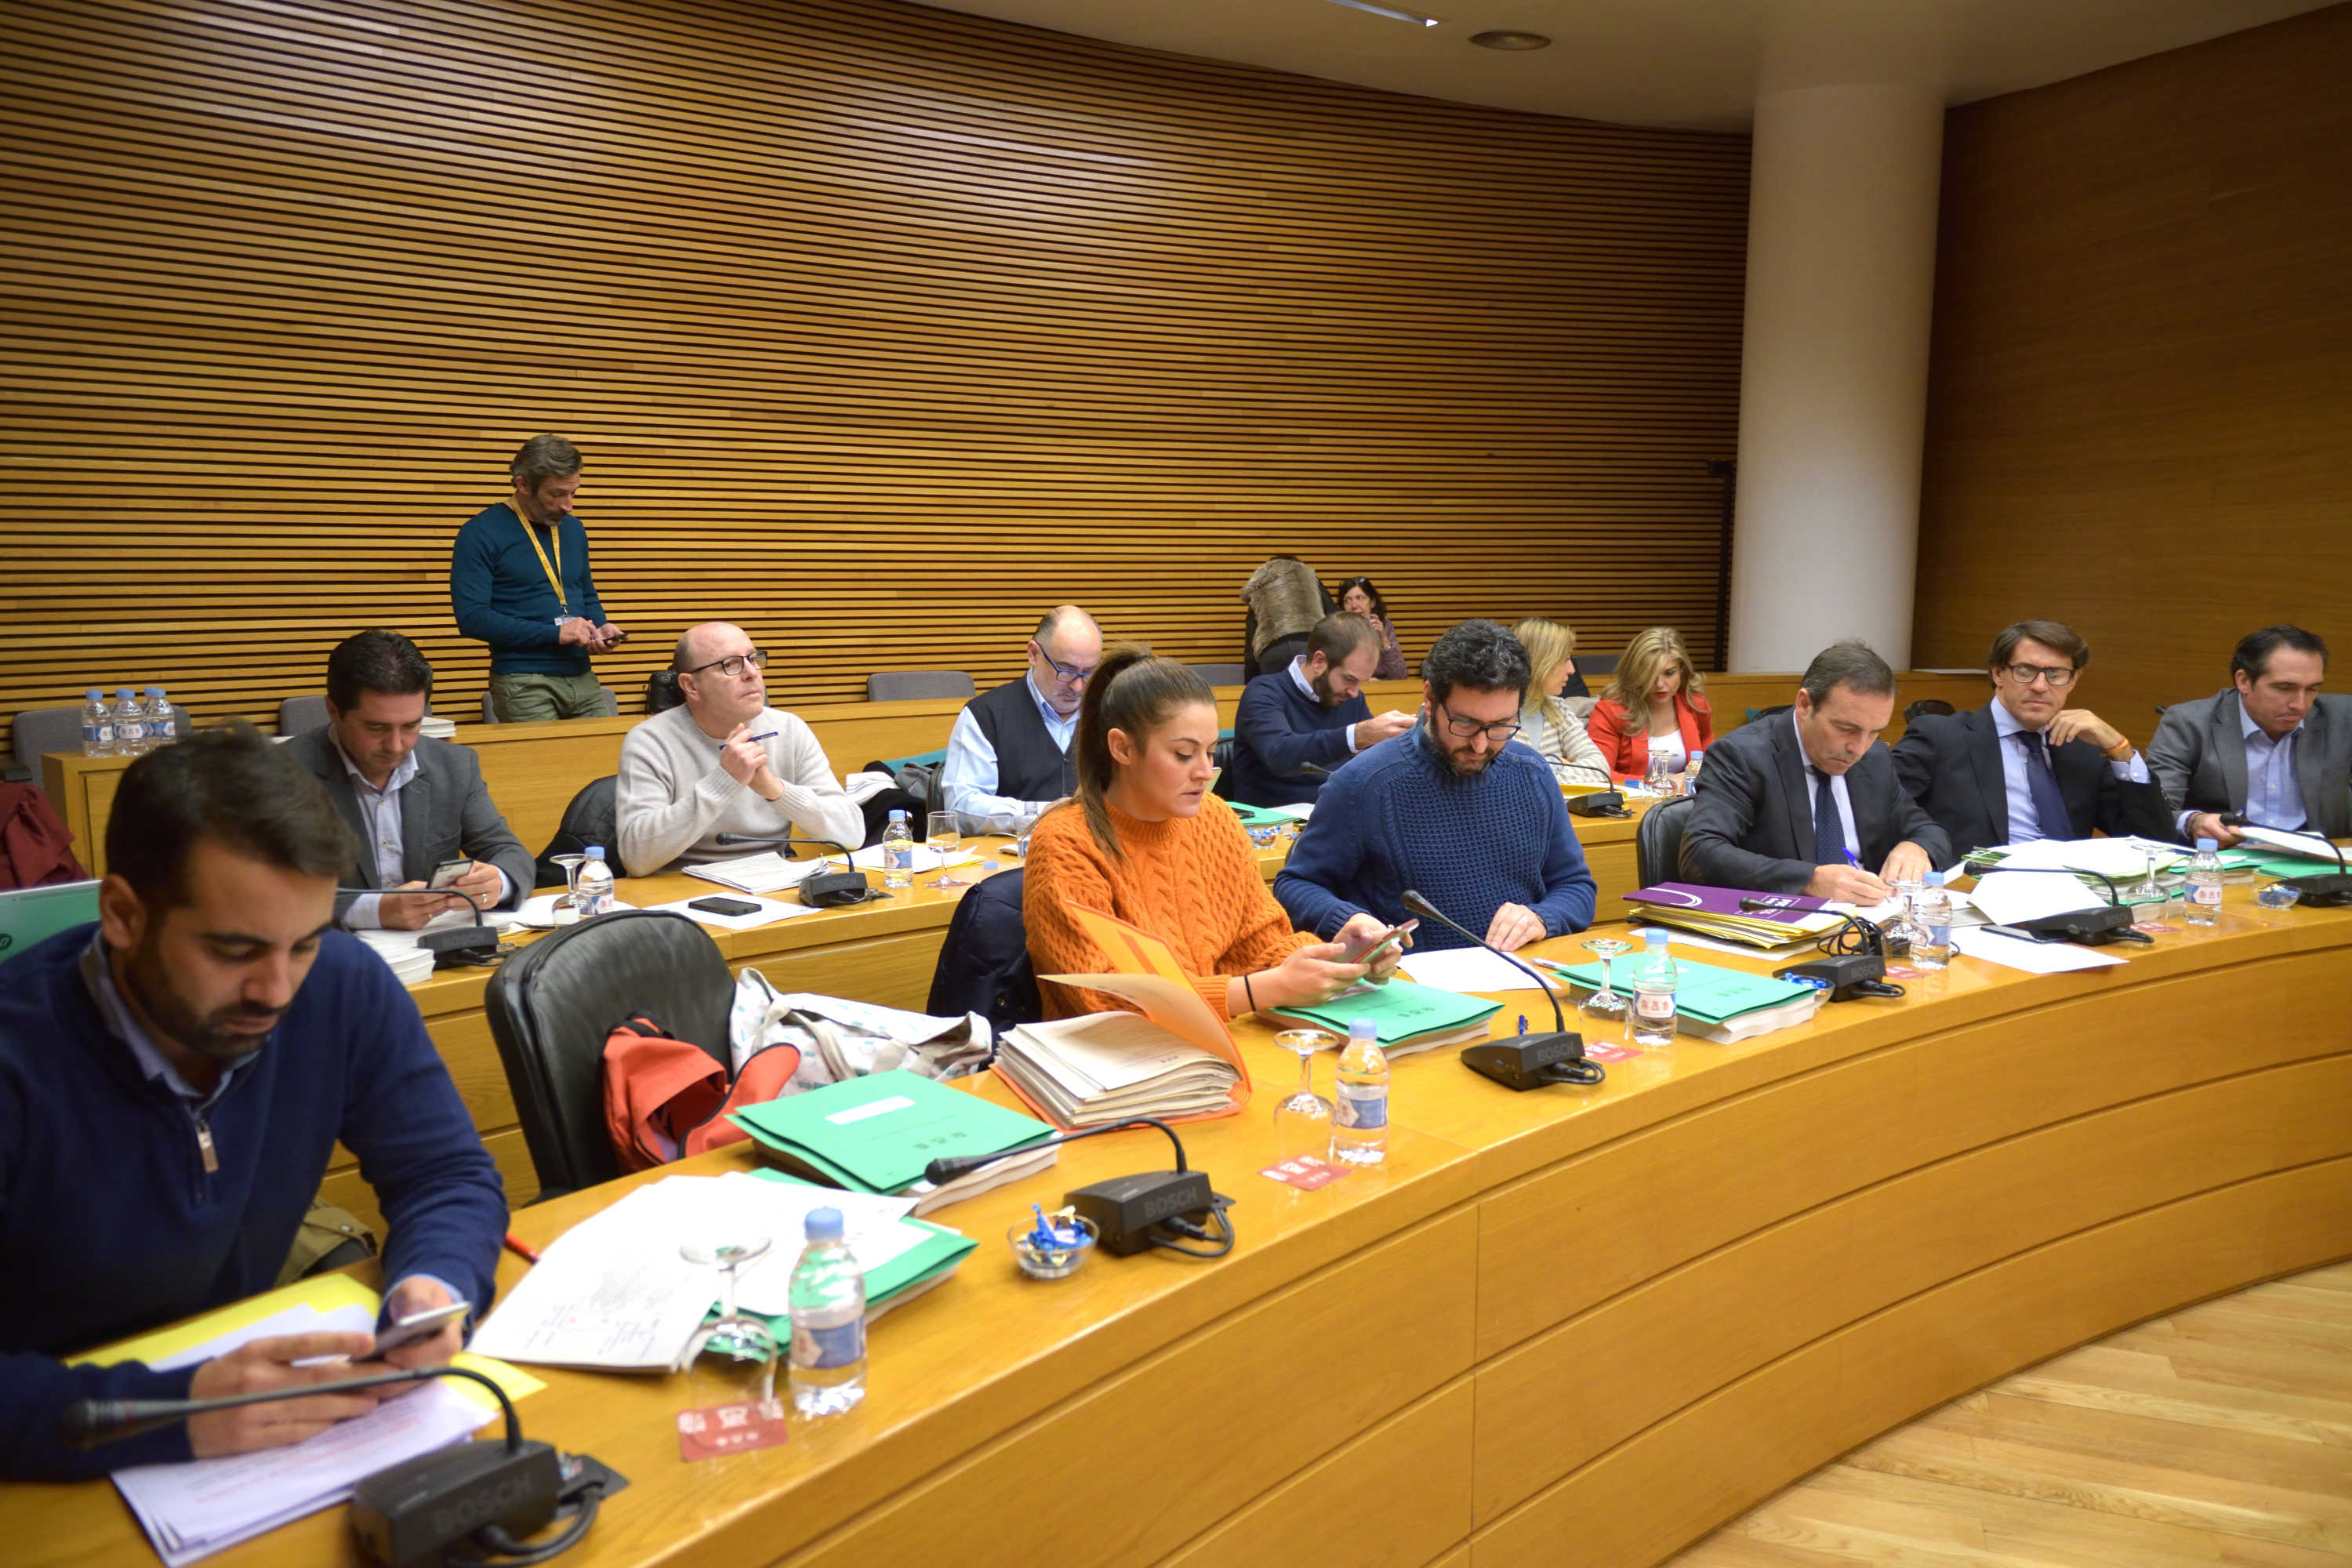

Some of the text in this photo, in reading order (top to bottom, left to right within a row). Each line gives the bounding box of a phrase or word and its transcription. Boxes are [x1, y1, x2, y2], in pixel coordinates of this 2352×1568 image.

[1537, 1040, 1574, 1062] BOSCH
[1144, 1185, 1198, 1218] BOSCH
[433, 1472, 532, 1534] BOSCH
